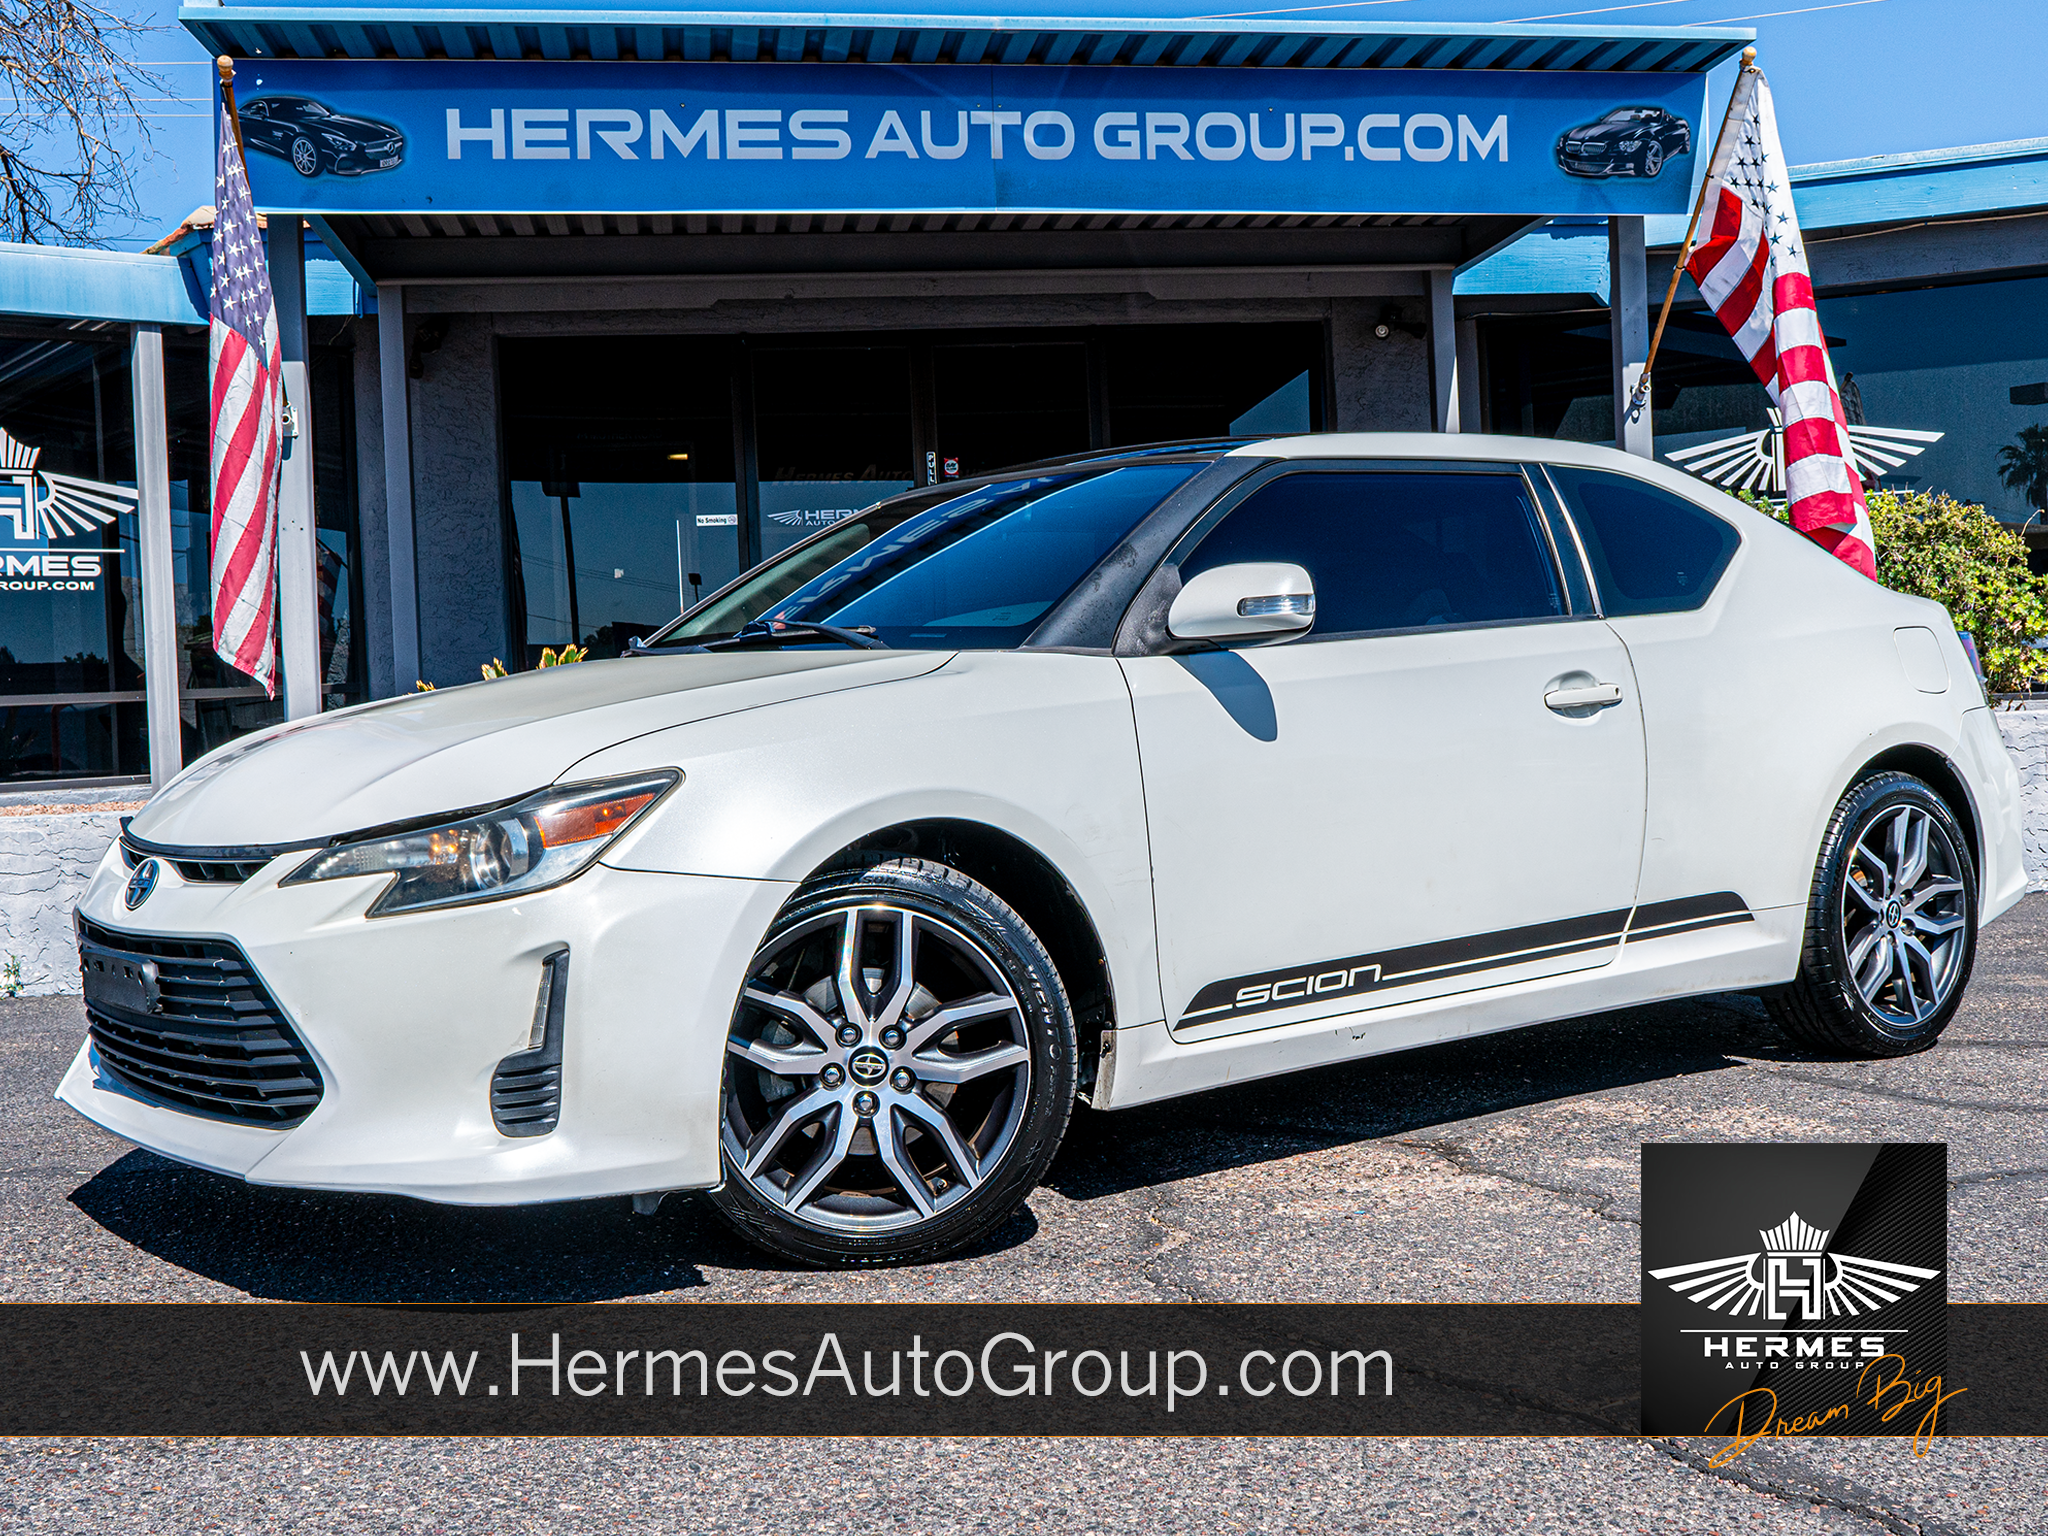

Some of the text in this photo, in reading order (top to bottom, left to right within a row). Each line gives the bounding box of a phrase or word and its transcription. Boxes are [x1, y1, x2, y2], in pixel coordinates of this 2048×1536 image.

[446, 108, 1508, 163] HERMES AUTO GROUP.COM
[705, 516, 727, 525] Smoking
[805, 519, 835, 527] AUTO
[0, 555, 102, 577] MES
[1235, 963, 1382, 1008] SCION
